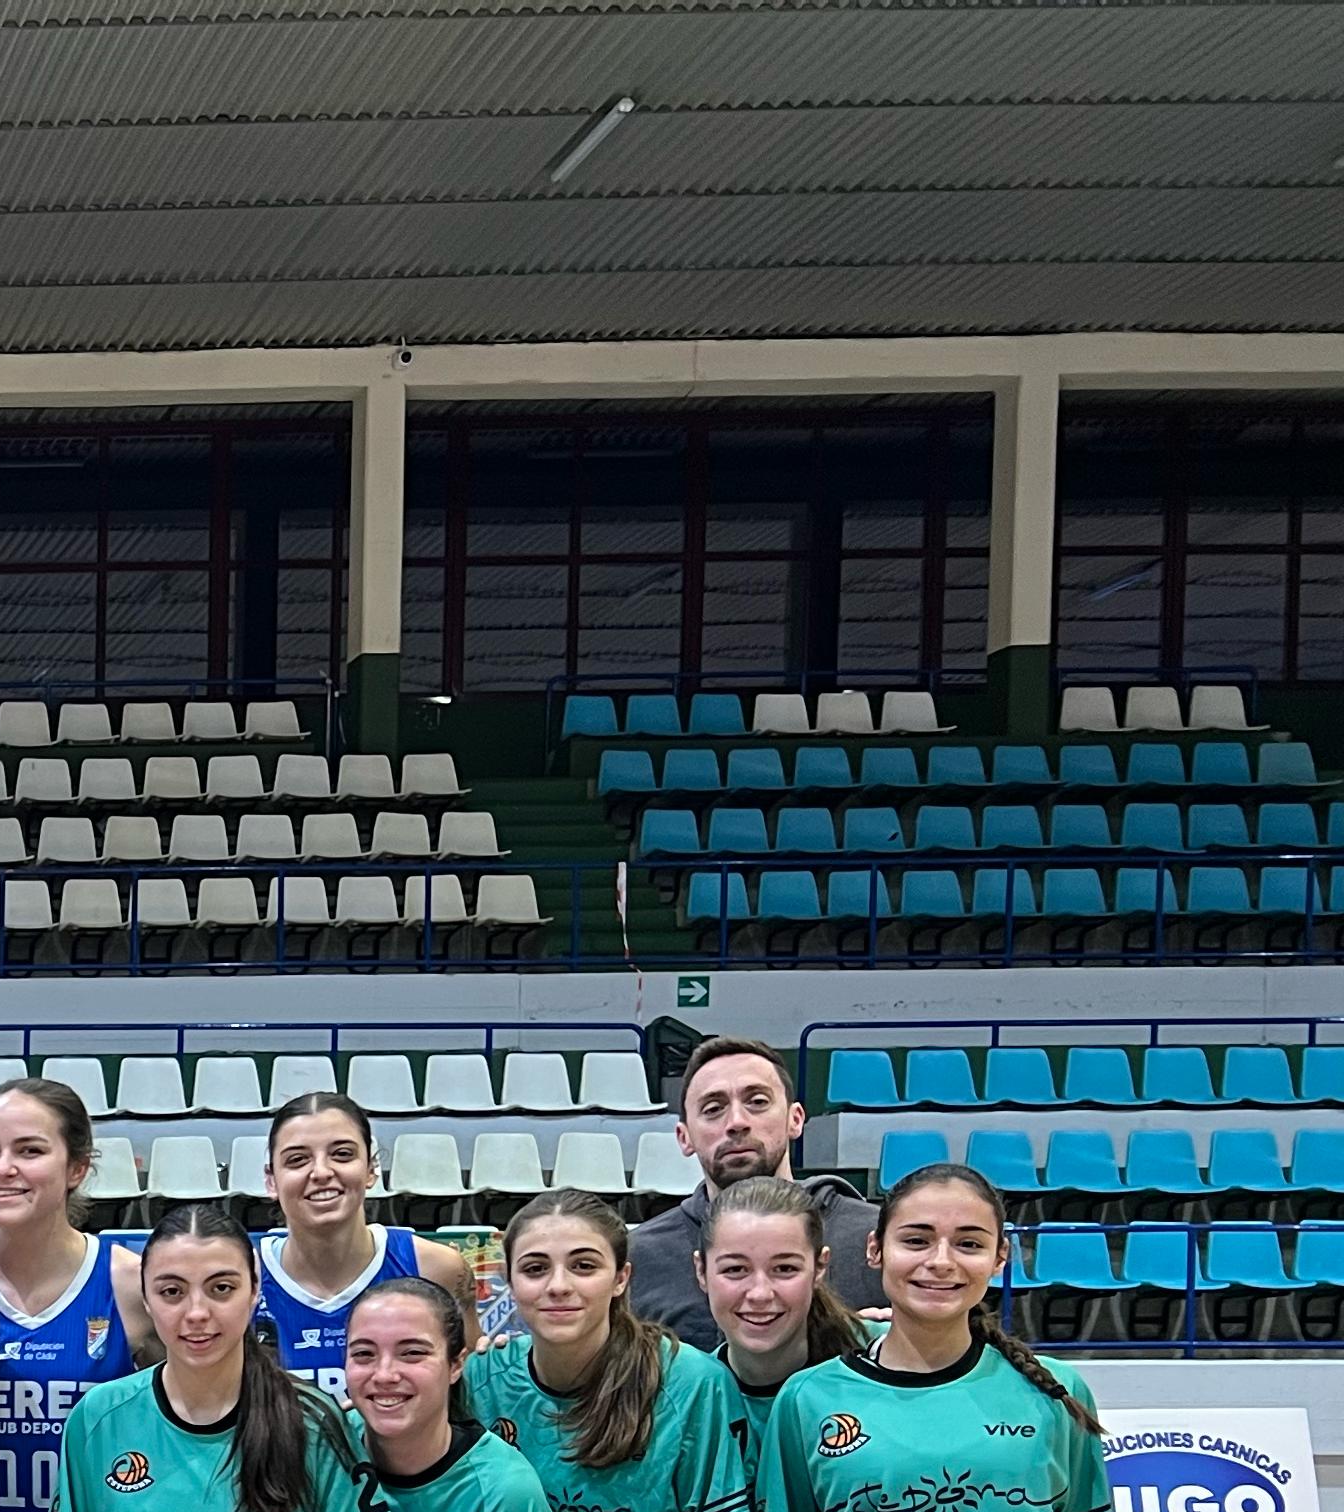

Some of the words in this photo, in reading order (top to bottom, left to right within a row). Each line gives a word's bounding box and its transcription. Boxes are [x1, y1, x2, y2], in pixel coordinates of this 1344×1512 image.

[21, 1422, 63, 1434] DEPO
[983, 1421, 1036, 1437] vive
[1199, 1435, 1292, 1485] CARNICAS
